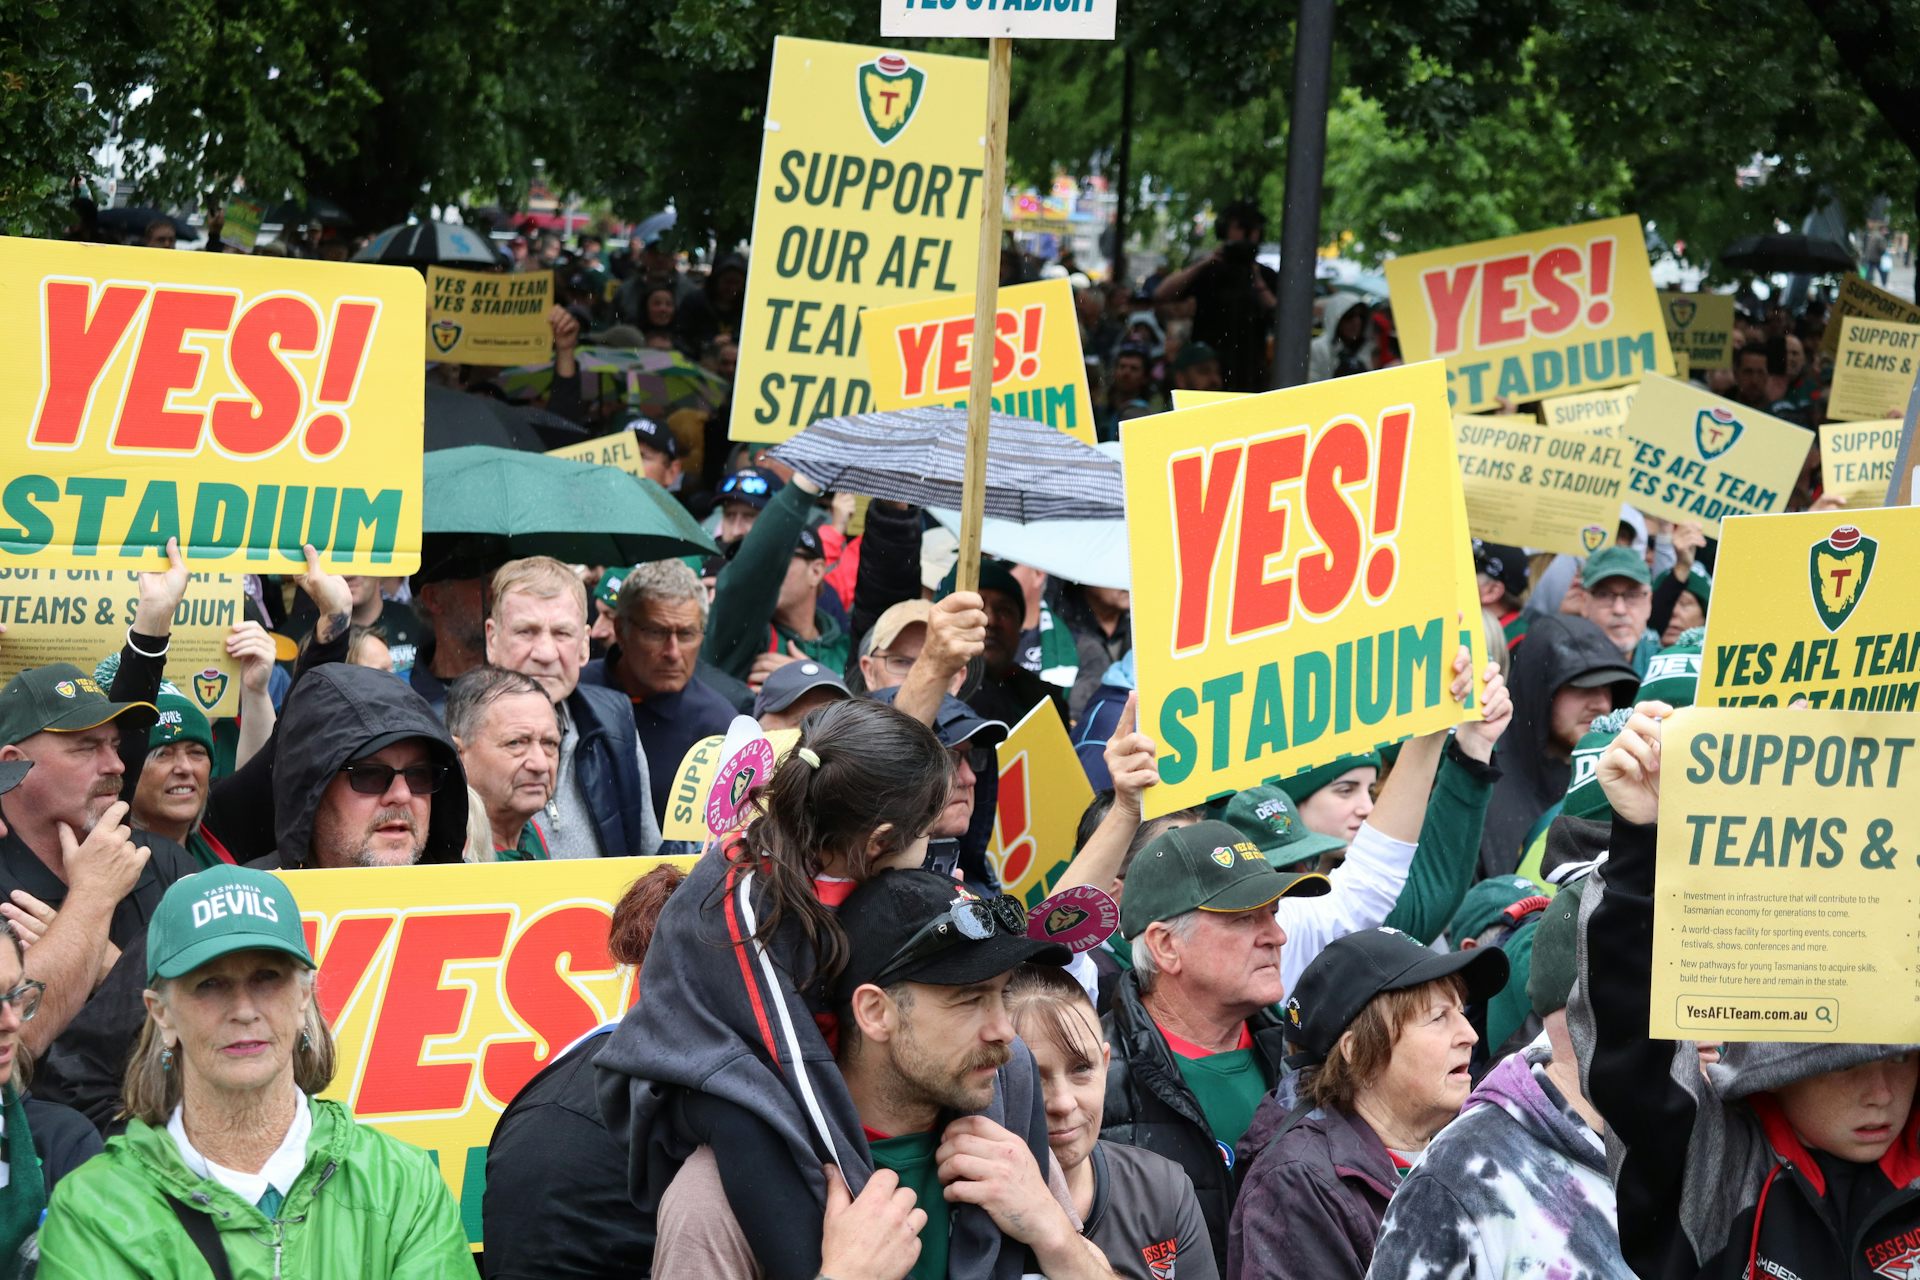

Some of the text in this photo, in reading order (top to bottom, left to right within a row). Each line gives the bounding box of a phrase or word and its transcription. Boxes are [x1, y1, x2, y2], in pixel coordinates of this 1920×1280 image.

[774, 149, 984, 219] SUPPORT
[775, 225, 956, 292] OUR AFL
[434, 276, 548, 297] YES AFL TEAM
[1423, 238, 1614, 354] YES!
[434, 296, 544, 316] YES STADIUM
[897, 305, 1043, 397] YES!
[1849, 326, 1919, 350] SUPPORT
[30, 278, 379, 459] YES!
[1846, 351, 1912, 374] TEAMS &
[754, 372, 876, 427] STAD
[1555, 400, 1620, 424] SUPPORT
[602, 443, 632, 464] AFL
[1460, 426, 1622, 468] SUPPORT OUR AFL
[1519, 466, 1534, 484] &
[1540, 468, 1620, 499] STADIUM
[1630, 437, 1777, 512] ES AFL TEAM
[1630, 468, 1660, 496] ES
[1, 474, 403, 565] STADIUM
[1170, 408, 1412, 655] YES!
[95, 597, 114, 625] &
[125, 598, 235, 627] SDIUM
[1714, 643, 1777, 687] YES
[1780, 639, 1840, 682] AFL
[1158, 617, 1444, 785] STADIUM
[718, 759, 738, 786] YES
[1687, 732, 1915, 789] SUPPORT
[1686, 814, 1897, 871] TEAMS &
[203, 884, 261, 896] TASMANIA
[1684, 892, 1880, 904] Investment in infrastructure that will contribute to the
[192, 891, 278, 928] DEVILS
[1096, 899, 1116, 928] TEAM
[1684, 906, 1724, 915] Tasmanian
[1726, 908, 1759, 918] economy
[1761, 908, 1772, 916] for
[1774, 908, 1816, 918] generations
[1818, 909, 1826, 917] to
[1682, 925, 1687, 934] A
[1688, 926, 1732, 936] world-class
[1734, 927, 1759, 937] facility
[1761, 928, 1771, 936] for
[1773, 928, 1803, 938] sporting
[1745, 943, 1789, 951] conferences
[1791, 943, 1805, 951] and
[1680, 974, 1698, 983] build
[1700, 975, 1717, 983] their
[1720, 975, 1742, 984] future
[1744, 976, 1761, 984] here
[1762, 977, 1776, 985] and
[1778, 977, 1804, 985] remain
[1805, 977, 1813, 985] in
[1815, 977, 1826, 985] the
[1681, 959, 1697, 969] New
[1699, 961, 1736, 971] pathways
[1737, 961, 1748, 970] for
[1750, 963, 1772, 972] young
[1774, 962, 1817, 971] Tasmanians
[1819, 963, 1827, 971] to
[1828, 963, 1856, 973] acquire
[1687, 1005, 1808, 1020] YesAFLTeam.com.au
